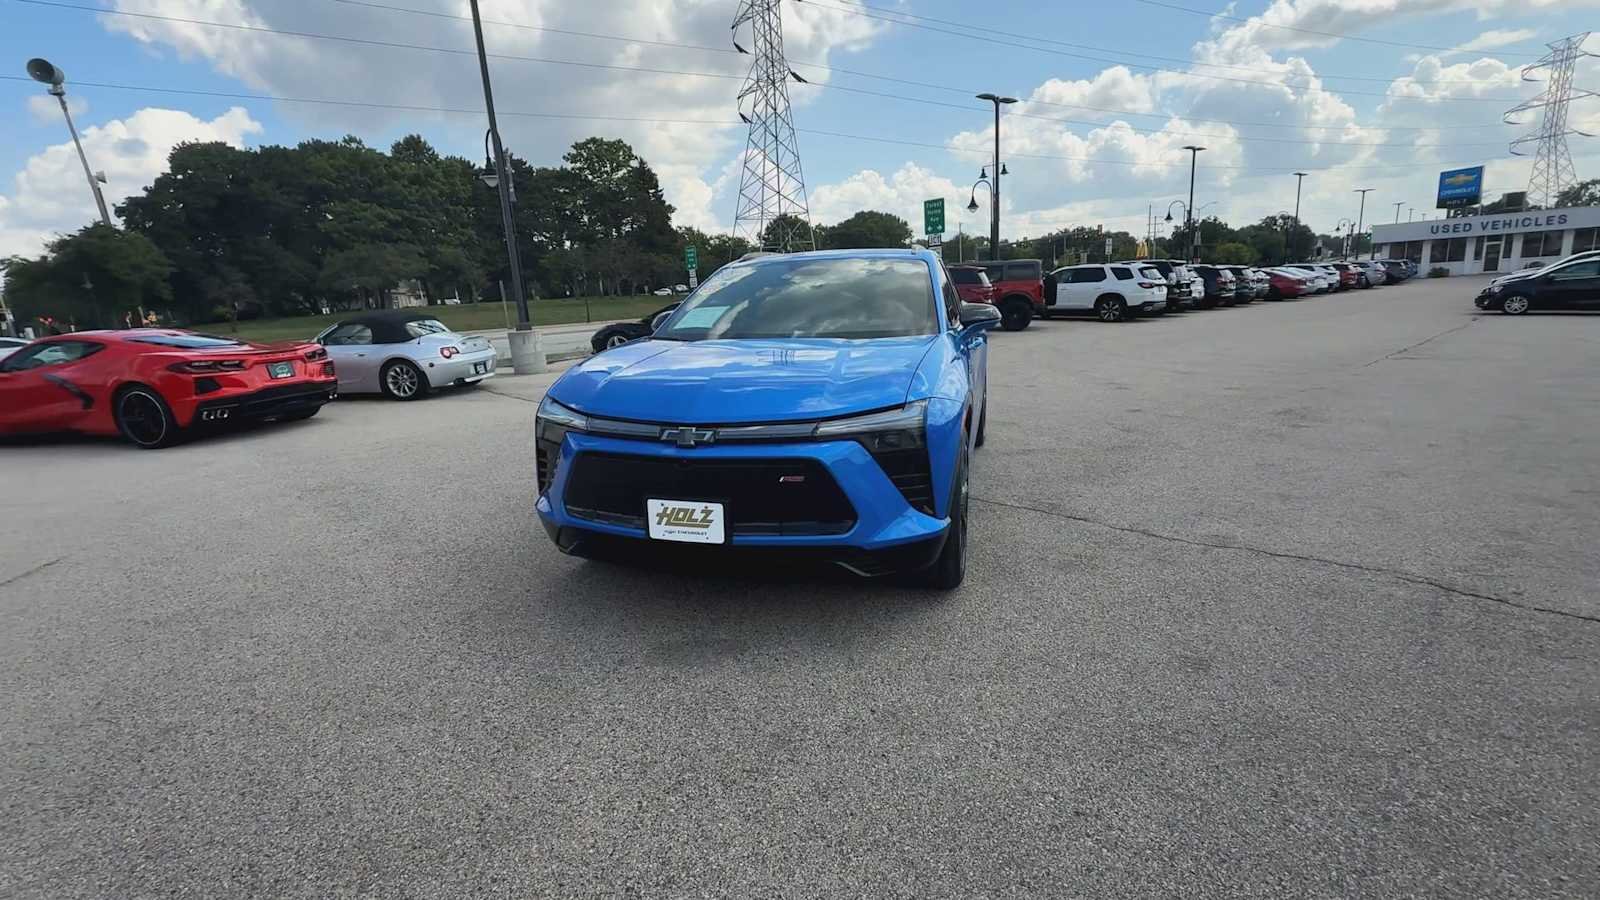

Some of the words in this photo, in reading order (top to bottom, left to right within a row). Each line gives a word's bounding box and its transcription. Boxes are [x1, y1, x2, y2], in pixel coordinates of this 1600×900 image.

[1430, 222, 1473, 235] USED
[1480, 214, 1568, 231] VEHICLES
[656, 506, 714, 528] HOLZ
